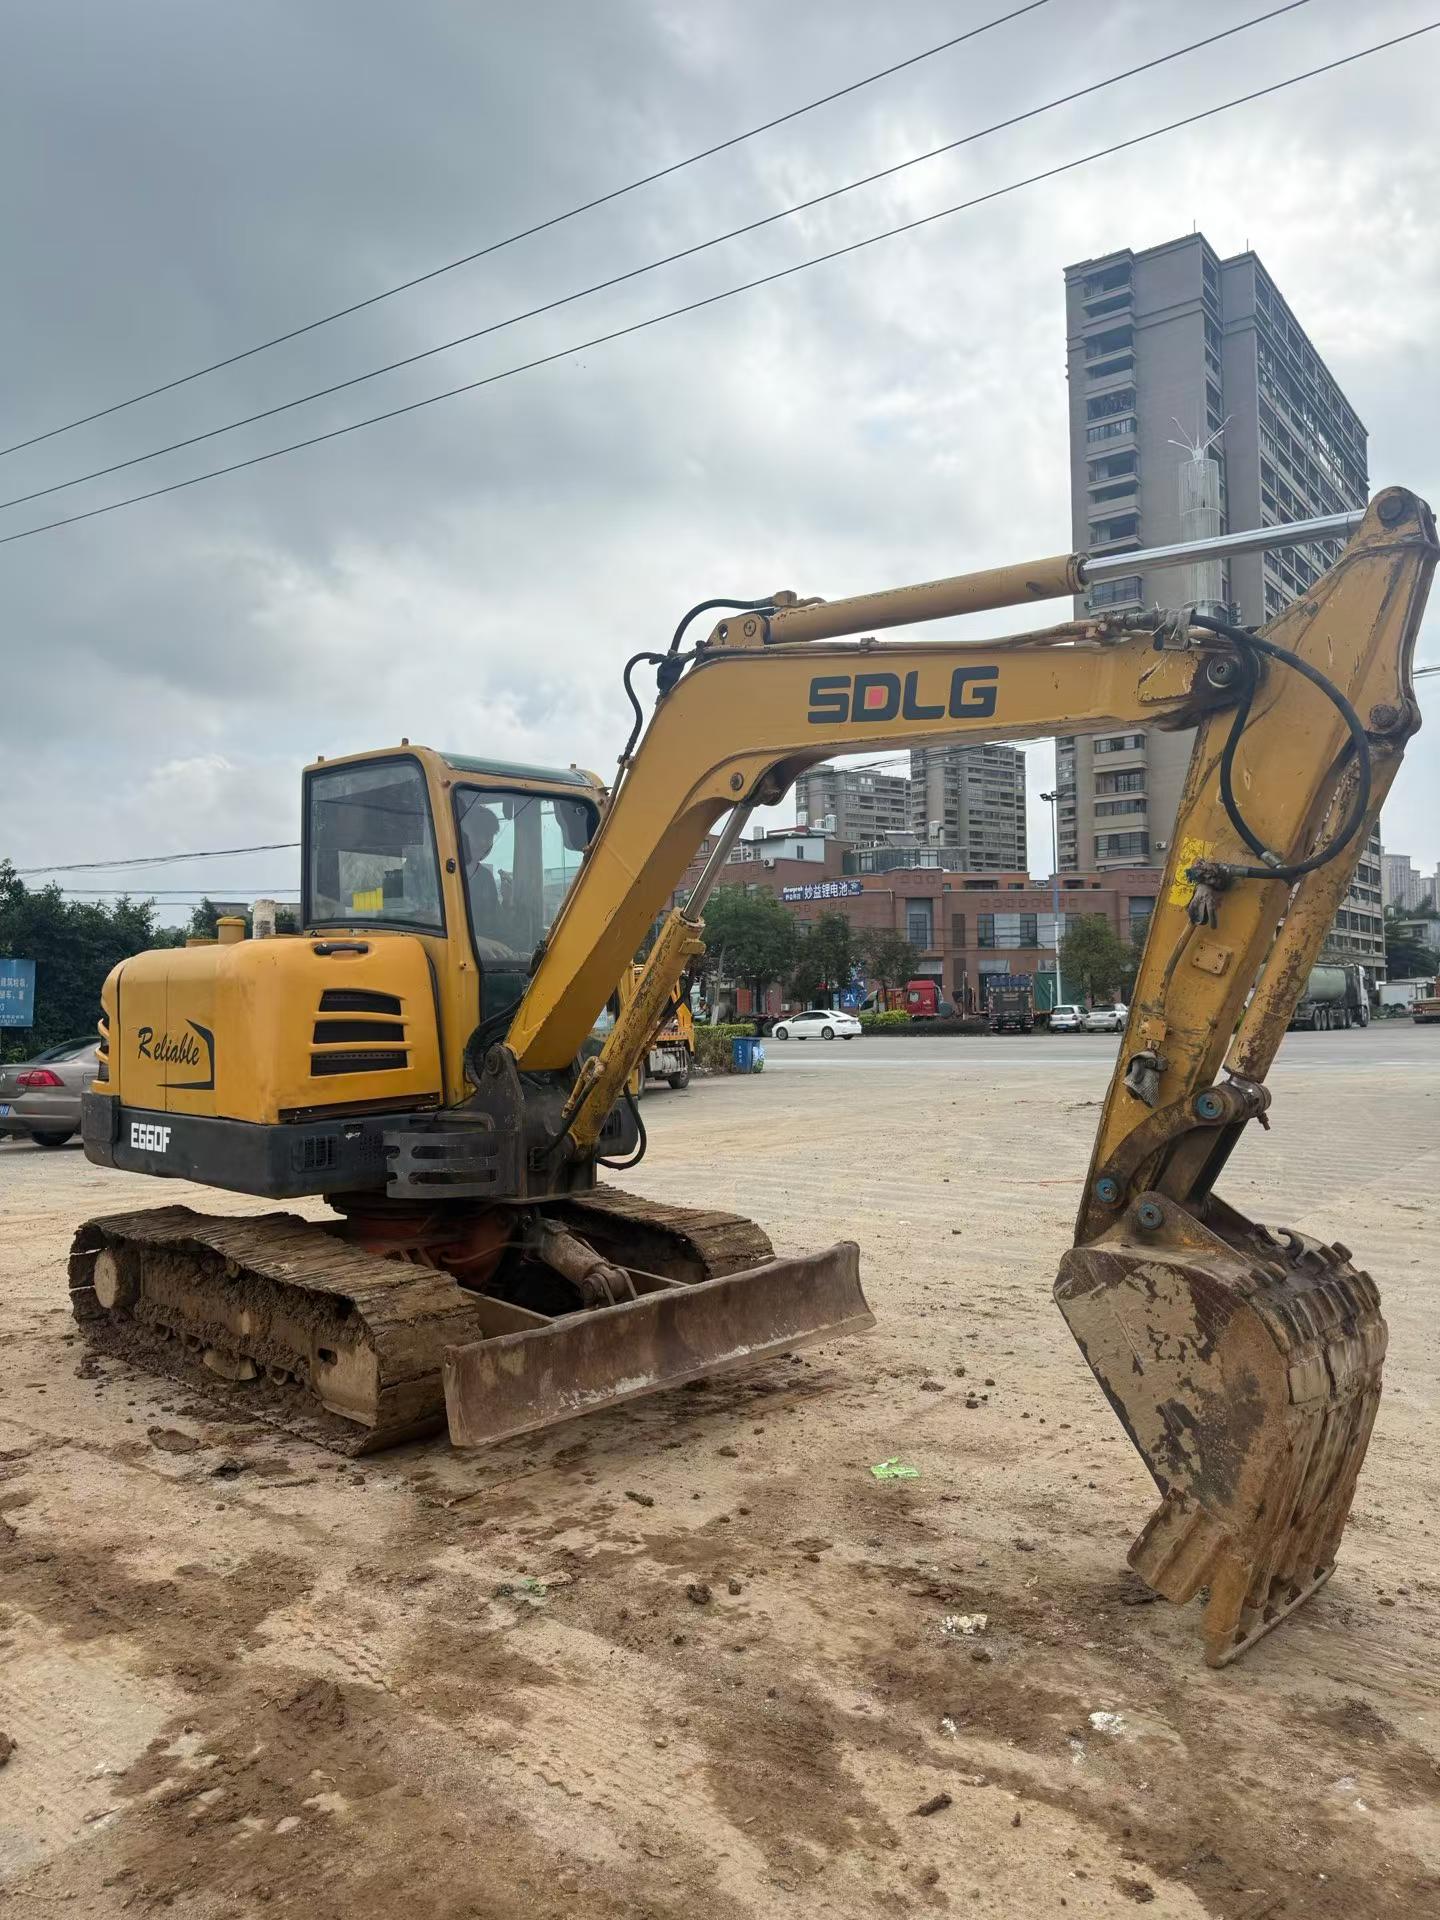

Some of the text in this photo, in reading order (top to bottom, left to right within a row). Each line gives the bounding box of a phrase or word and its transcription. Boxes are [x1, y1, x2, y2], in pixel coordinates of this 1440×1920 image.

[808, 666, 999, 724] SDLG
[804, 882, 848, 899] 妙益锂电池
[138, 1026, 200, 1066] Reliable
[131, 1122, 171, 1152] E660F
